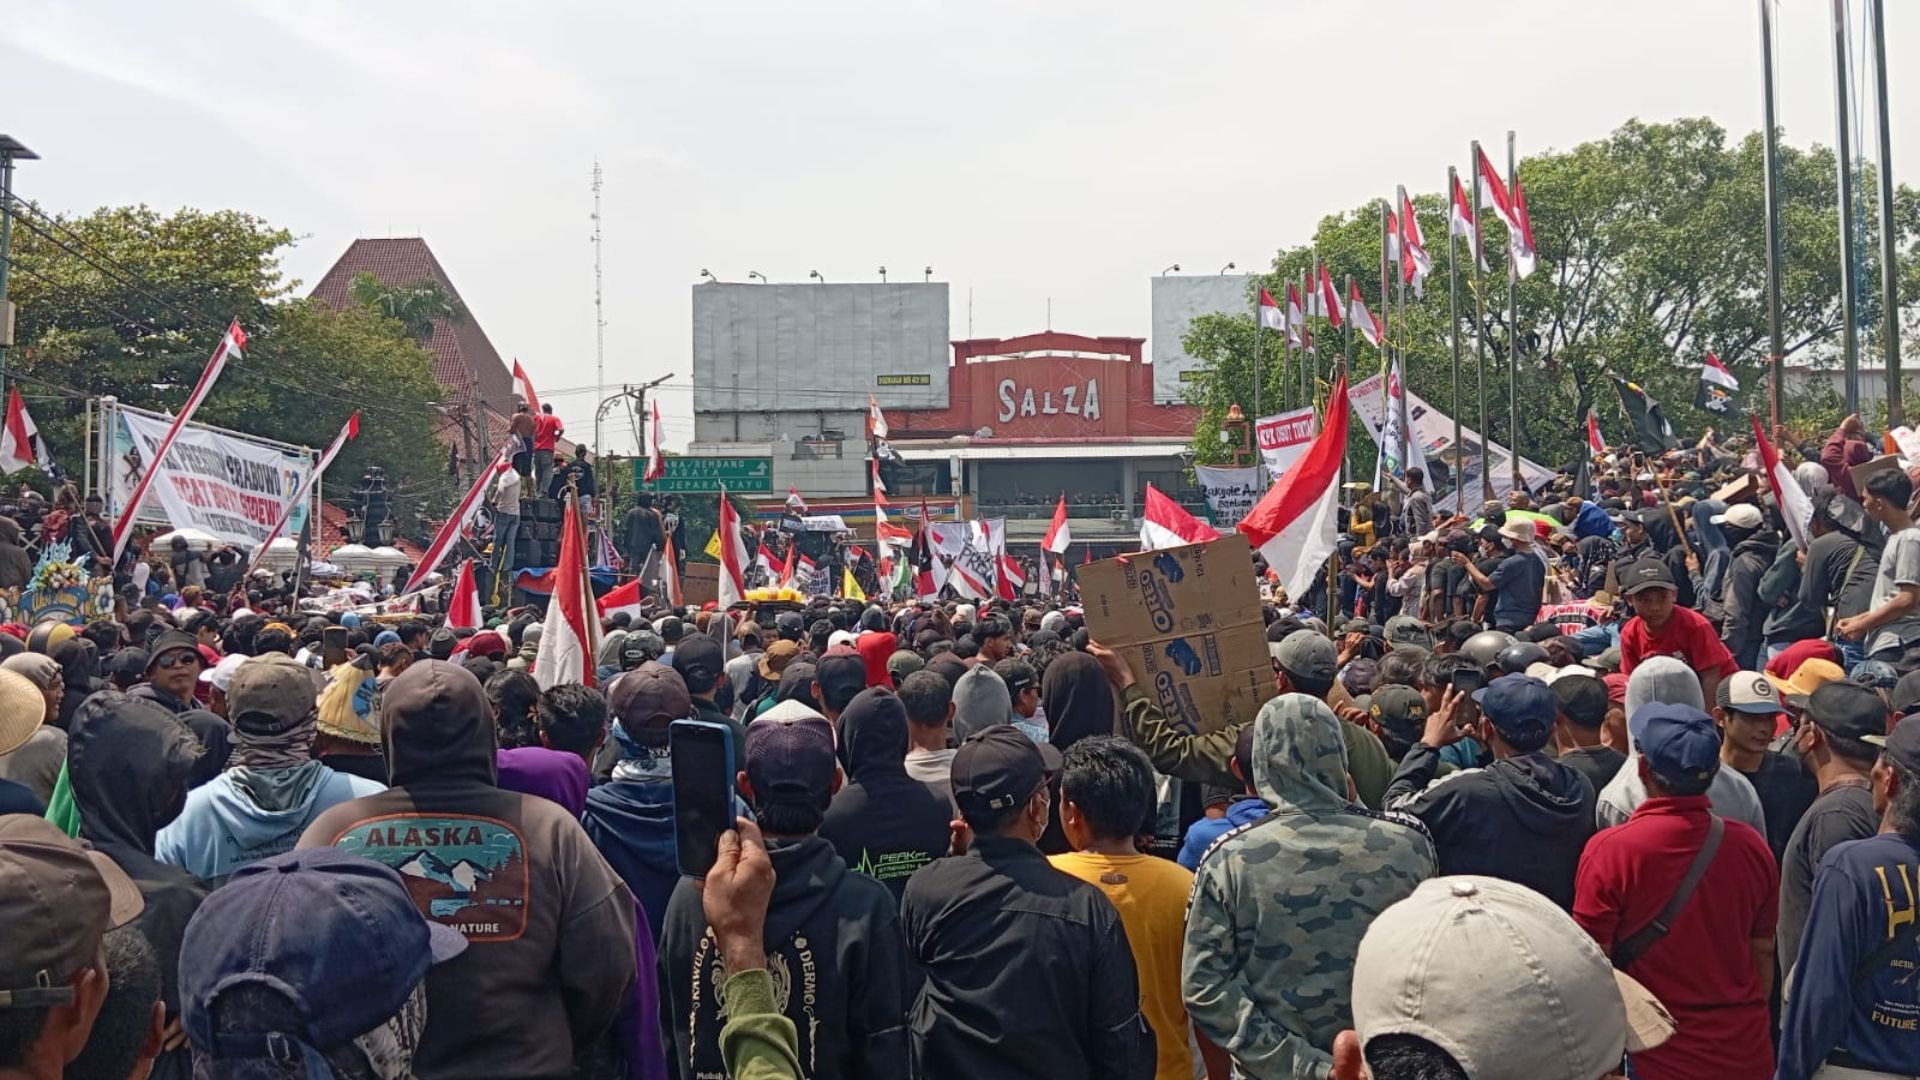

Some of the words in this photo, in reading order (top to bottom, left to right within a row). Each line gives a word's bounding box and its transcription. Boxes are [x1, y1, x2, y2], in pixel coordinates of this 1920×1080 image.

[999, 378, 1100, 423] SALZA
[1139, 569, 1175, 634] OREO
[365, 826, 484, 848] ALASKA
[692, 938, 709, 1000] KAWULO
[800, 949, 816, 1005] DERMO
[1871, 1010, 1918, 1030] FUTURE
